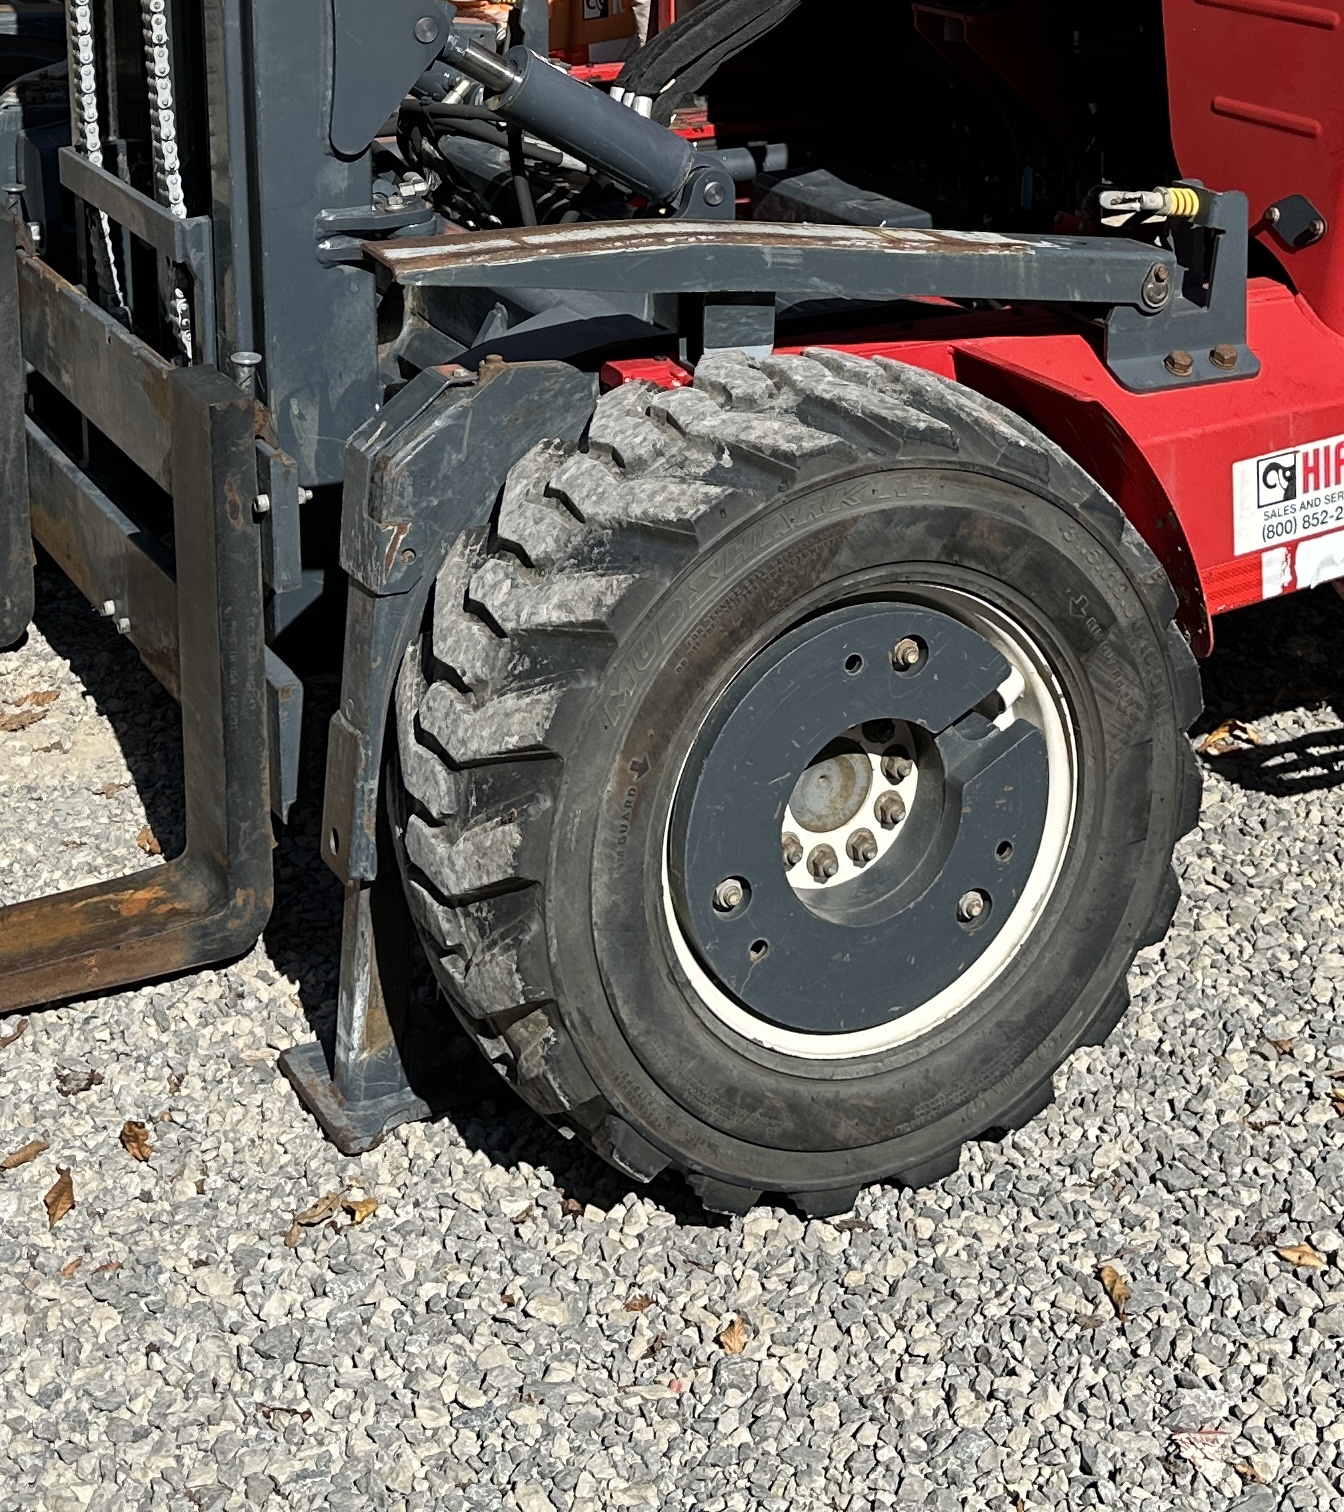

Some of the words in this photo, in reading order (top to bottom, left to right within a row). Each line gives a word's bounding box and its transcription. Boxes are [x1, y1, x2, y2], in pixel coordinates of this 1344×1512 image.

[1263, 503, 1297, 522] SALES
[1299, 497, 1322, 512] AND
[1261, 518, 1298, 543] (800)
